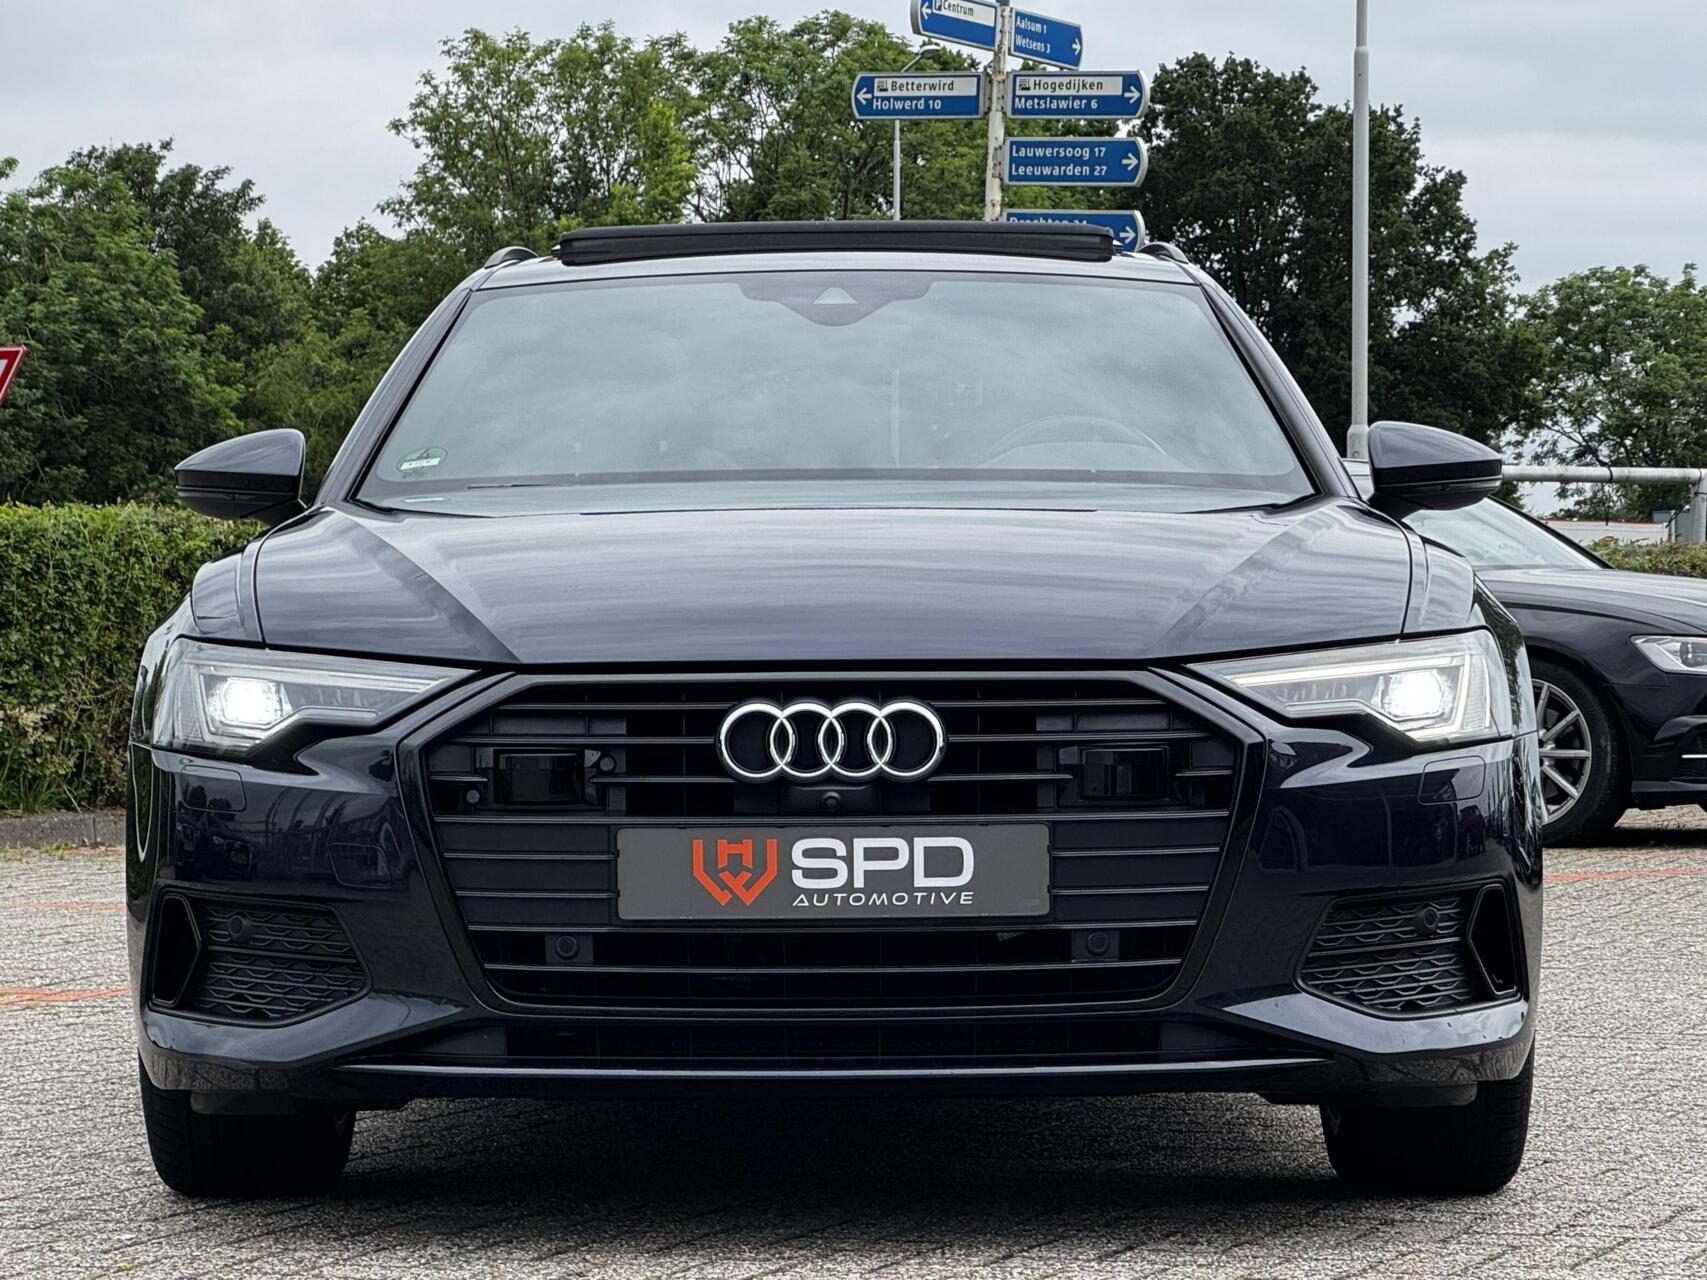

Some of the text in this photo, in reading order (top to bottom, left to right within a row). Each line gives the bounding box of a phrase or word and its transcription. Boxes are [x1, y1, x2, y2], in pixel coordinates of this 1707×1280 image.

[943, 0, 974, 16] Centrum
[1016, 16, 1047, 35] Aalsum 1
[1015, 34, 1051, 54] Wetsens 3
[891, 80, 954, 92] Betterwird
[1033, 79, 1103, 93] Hogedijken
[873, 98, 942, 110] Holwerd 10
[1014, 97, 1098, 109] Metslawier 6
[1012, 145, 1106, 160] Lauwersoog 17
[1011, 163, 1107, 176] Leeuwarden 27
[791, 836, 975, 889] SPD
[792, 891, 975, 906] AUTOMOTIVE
